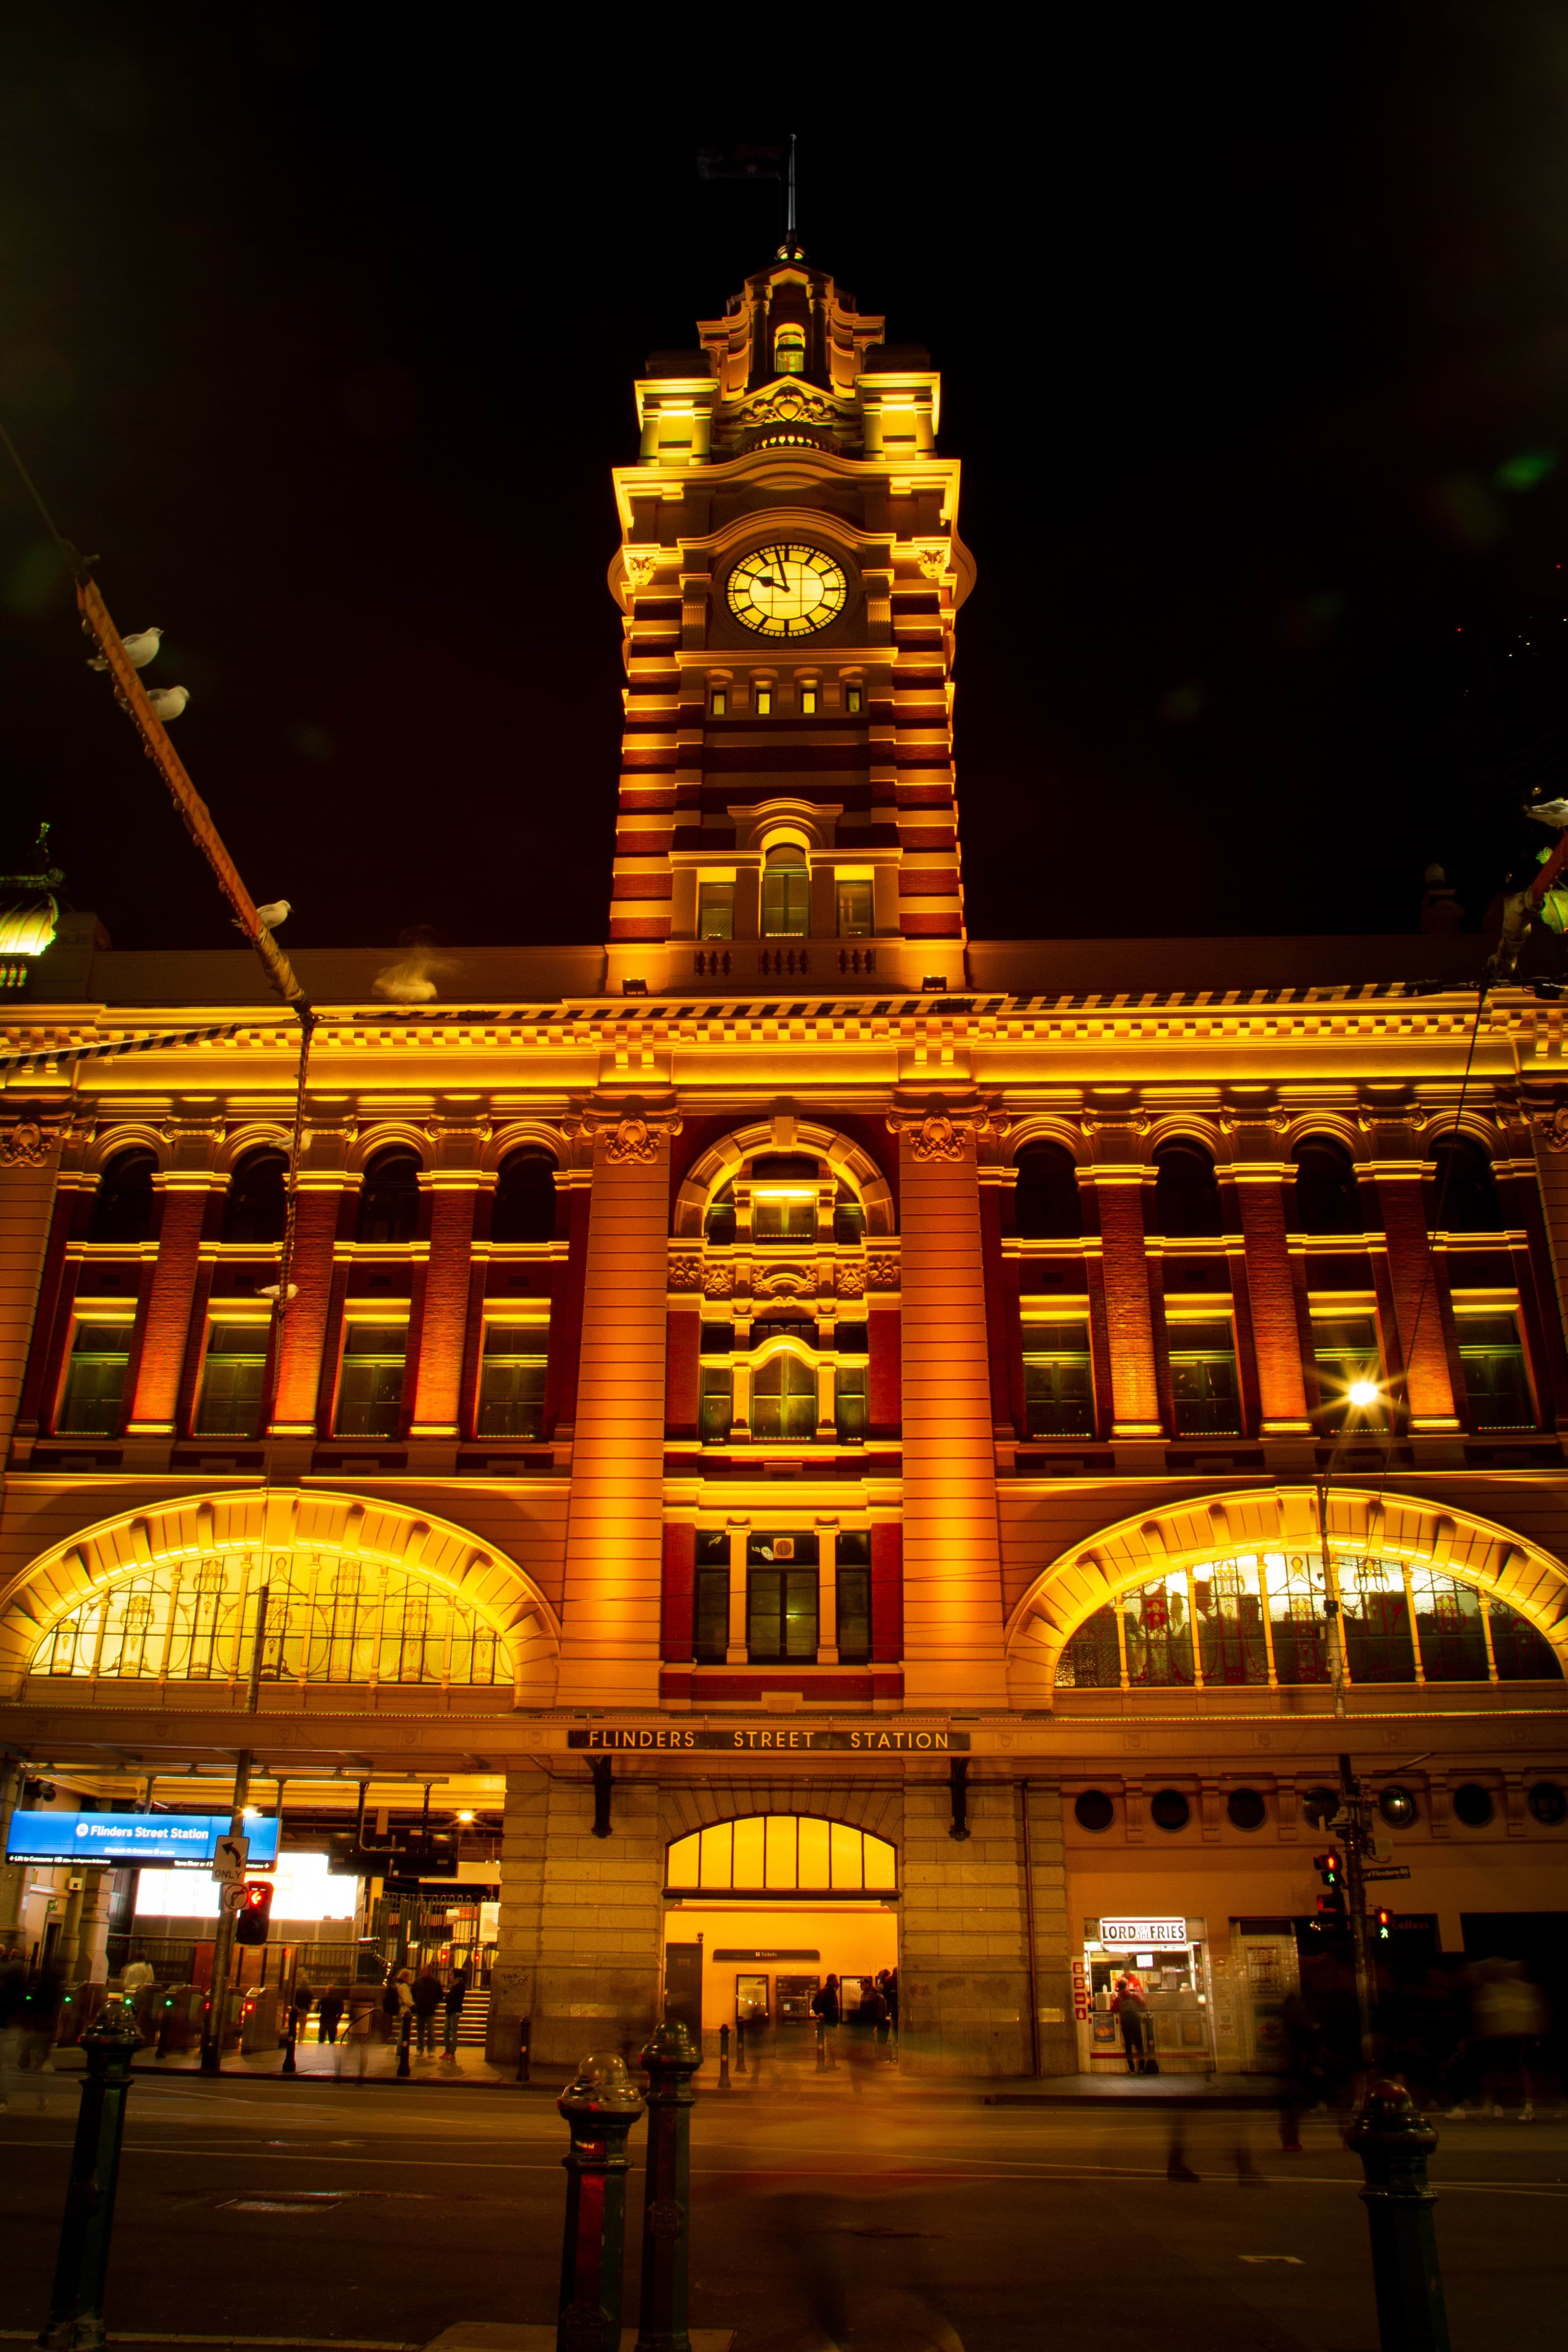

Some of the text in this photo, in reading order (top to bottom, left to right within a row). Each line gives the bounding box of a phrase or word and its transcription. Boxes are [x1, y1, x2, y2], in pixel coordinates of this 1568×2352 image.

[589, 1731, 949, 1749] FLINDERS STREET STATION
[90, 1825, 209, 1840] Flinders Street Station
[214, 1869, 242, 1879] ONLY
[1102, 1925, 1136, 1939] LORD
[1150, 1925, 1184, 1938] FRIES
